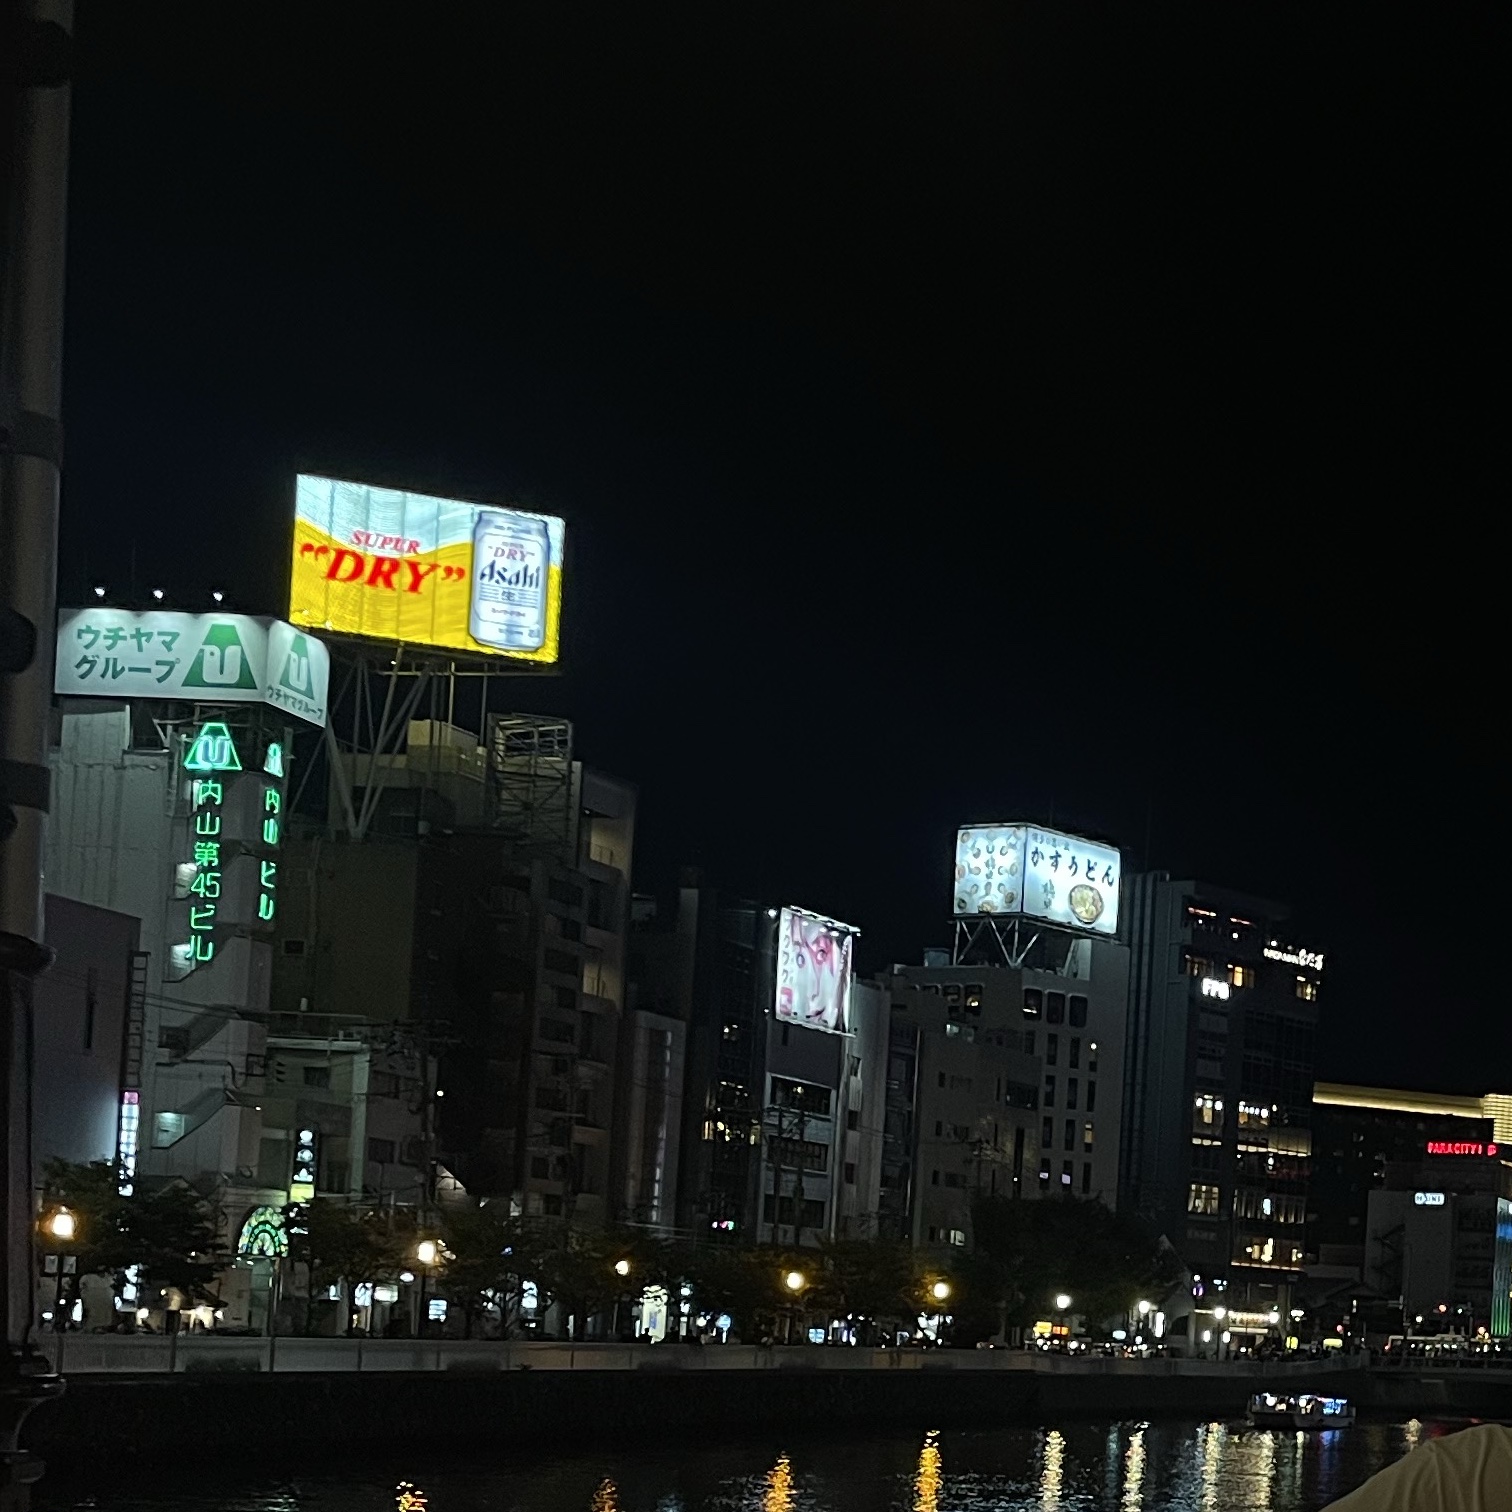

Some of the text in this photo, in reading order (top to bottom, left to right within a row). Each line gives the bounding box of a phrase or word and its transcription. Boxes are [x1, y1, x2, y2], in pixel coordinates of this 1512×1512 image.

[352, 529, 421, 555] SUPER
[479, 559, 541, 589] Asahi
[76, 625, 181, 652] ウチヤマ
[73, 654, 182, 685] グループ
[185, 779, 222, 962] 内山第45ビル
